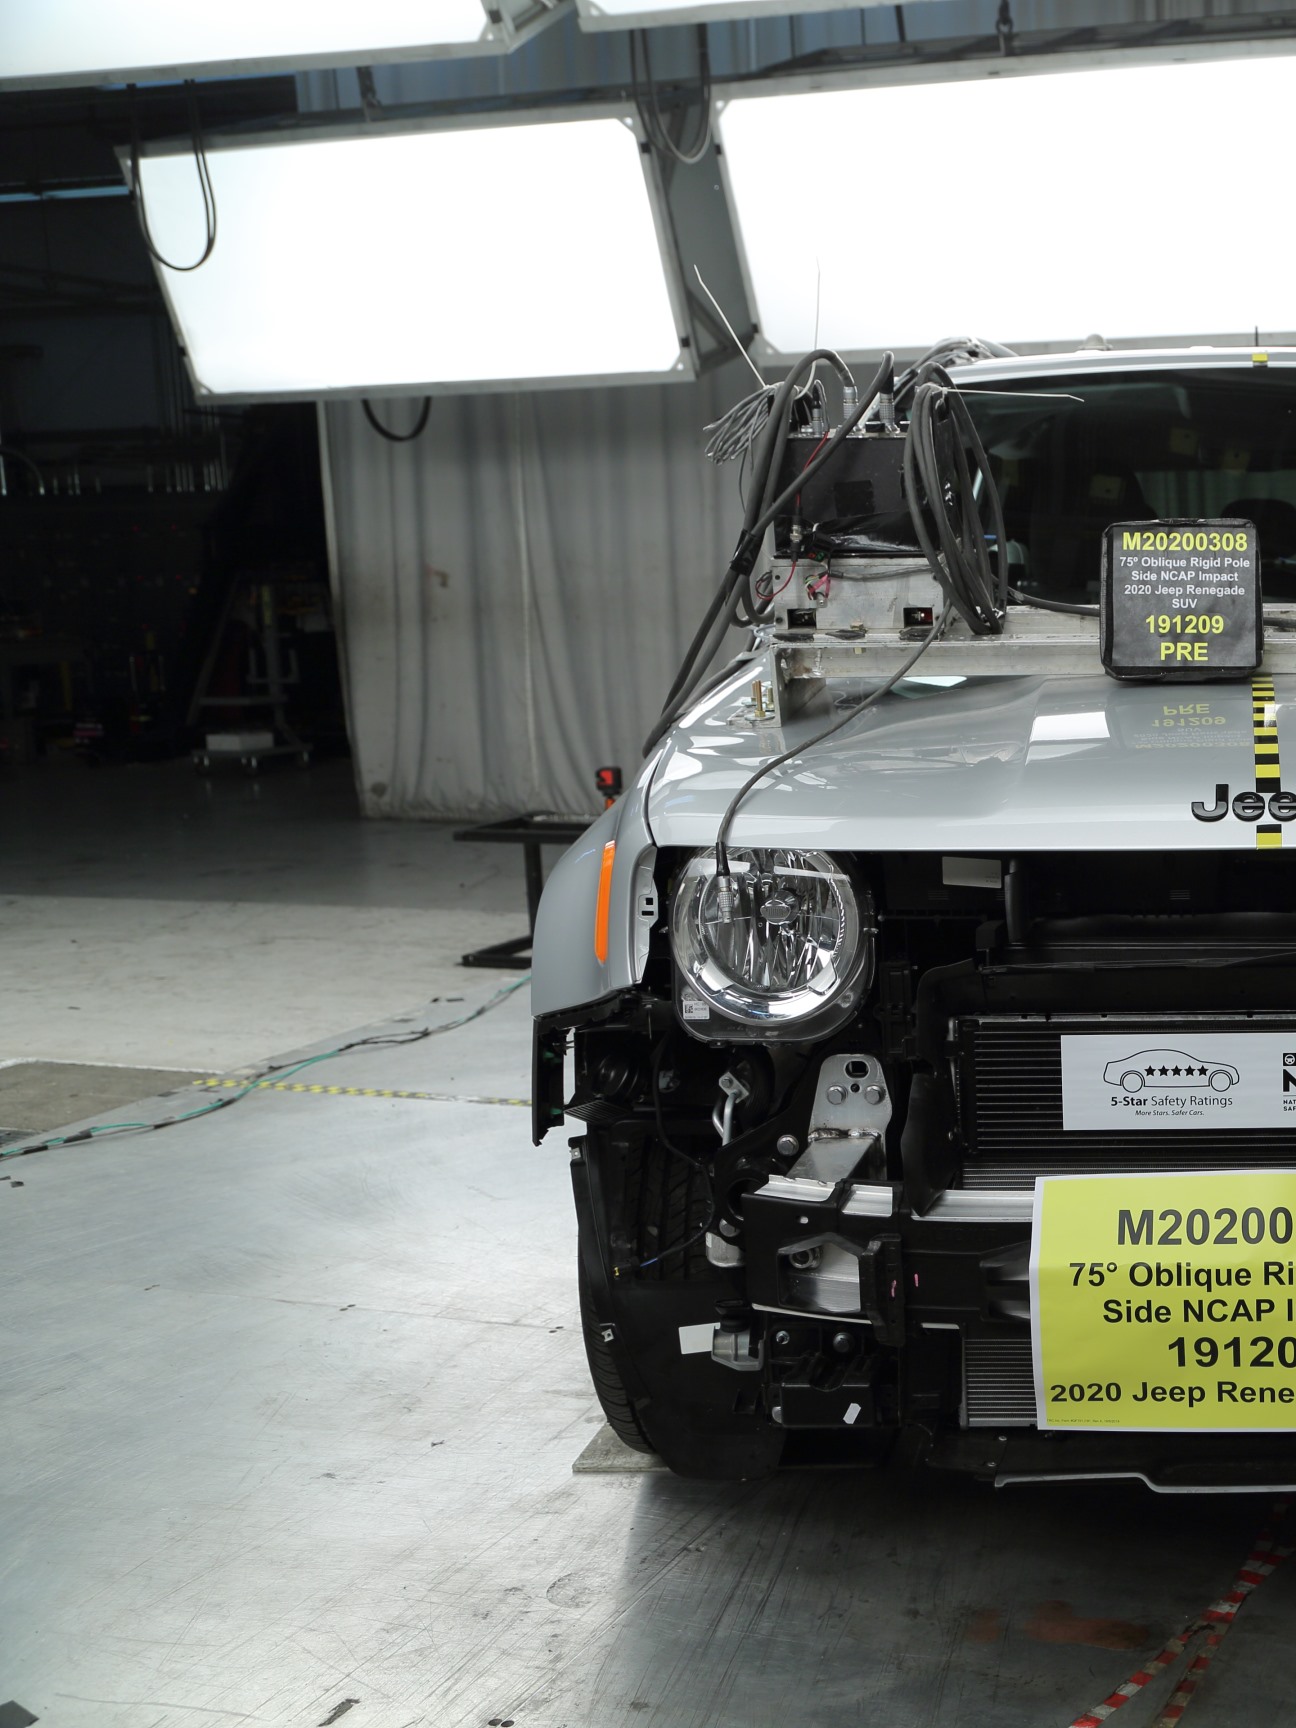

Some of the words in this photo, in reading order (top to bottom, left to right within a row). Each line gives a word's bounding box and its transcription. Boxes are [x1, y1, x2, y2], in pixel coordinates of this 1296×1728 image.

[1122, 532, 1248, 551] M20200308
[1141, 557, 1187, 569] Oblique
[1190, 557, 1221, 570] Rigid
[1224, 557, 1250, 568] Pole
[1131, 571, 1157, 581] Side
[1160, 571, 1195, 581] NCAP
[1198, 571, 1239, 583] Impact
[1124, 584, 1151, 595] 2020
[1155, 585, 1183, 597] Jeep
[1186, 585, 1245, 597] Renegade
[1172, 598, 1198, 609] SUV
[1145, 615, 1224, 634] 191209
[1160, 642, 1209, 661] PRE
[1111, 1096, 1148, 1106] 5-Star
[1151, 1095, 1187, 1109] Safety
[1190, 1095, 1233, 1109] Ratings
[1069, 1262, 1118, 1287] 75°
[1128, 1260, 1252, 1293] Oblique
[1102, 1299, 1172, 1324] Side
[1183, 1298, 1276, 1323] NCAP
[1050, 1382, 1122, 1403] 2020
[1132, 1381, 1206, 1408] Jeep
